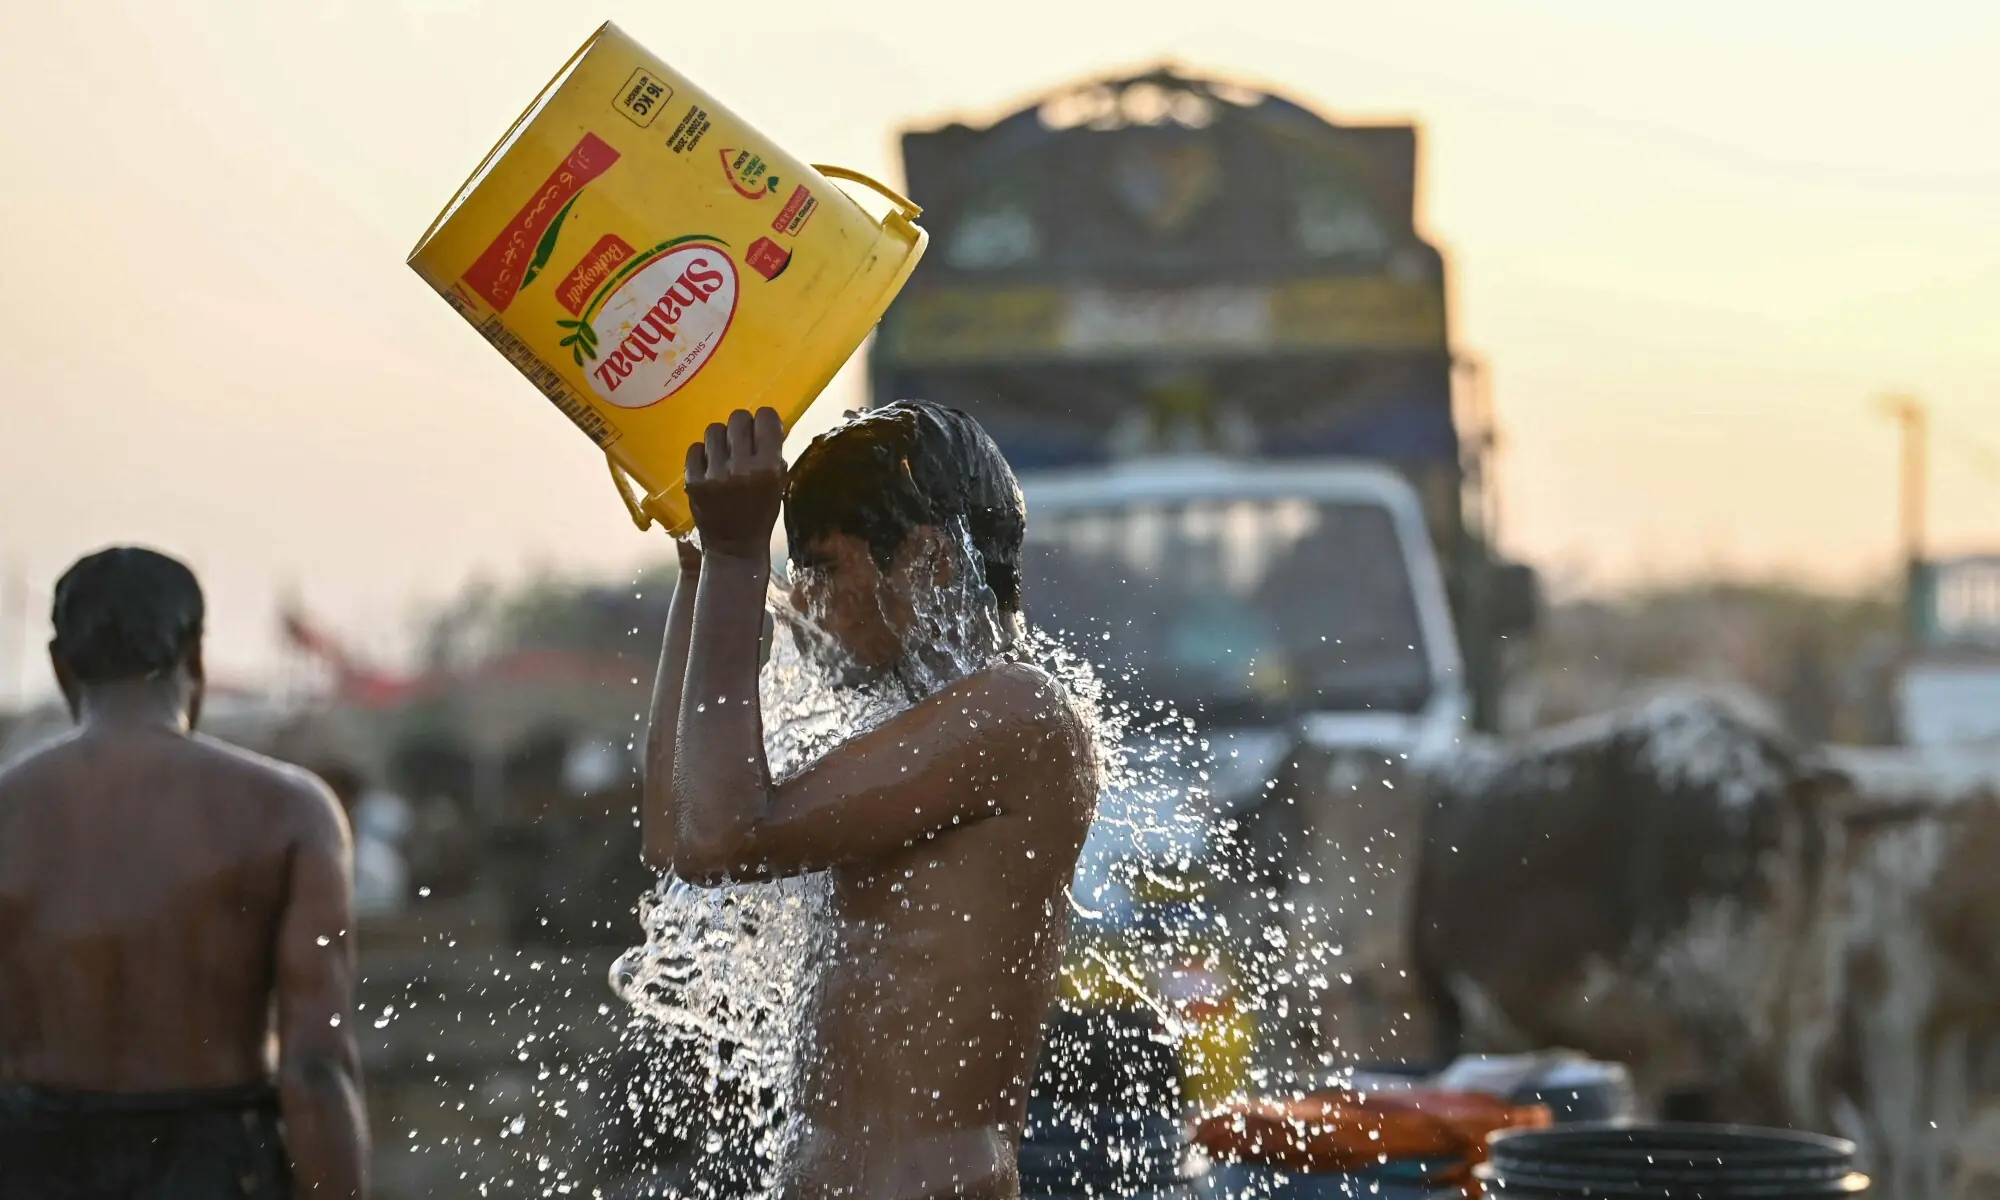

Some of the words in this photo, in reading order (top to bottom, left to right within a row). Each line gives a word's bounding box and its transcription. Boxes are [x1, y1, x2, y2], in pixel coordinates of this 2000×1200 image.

[638, 75, 649, 86] NET
[645, 82, 664, 98] 16
[622, 84, 642, 107] WEIGHT
[631, 93, 655, 116] KG
[696, 109, 707, 121] ISO
[664, 122, 686, 148] COMPANY
[671, 136, 688, 154] 2018
[732, 149, 749, 170] BLEND
[522, 183, 563, 230] صحت
[774, 221, 783, 230] D
[788, 216, 800, 231] WITH
[591, 259, 724, 392] Shahbaz
[683, 340, 706, 364] SINCE
[669, 361, 687, 380] 1983
